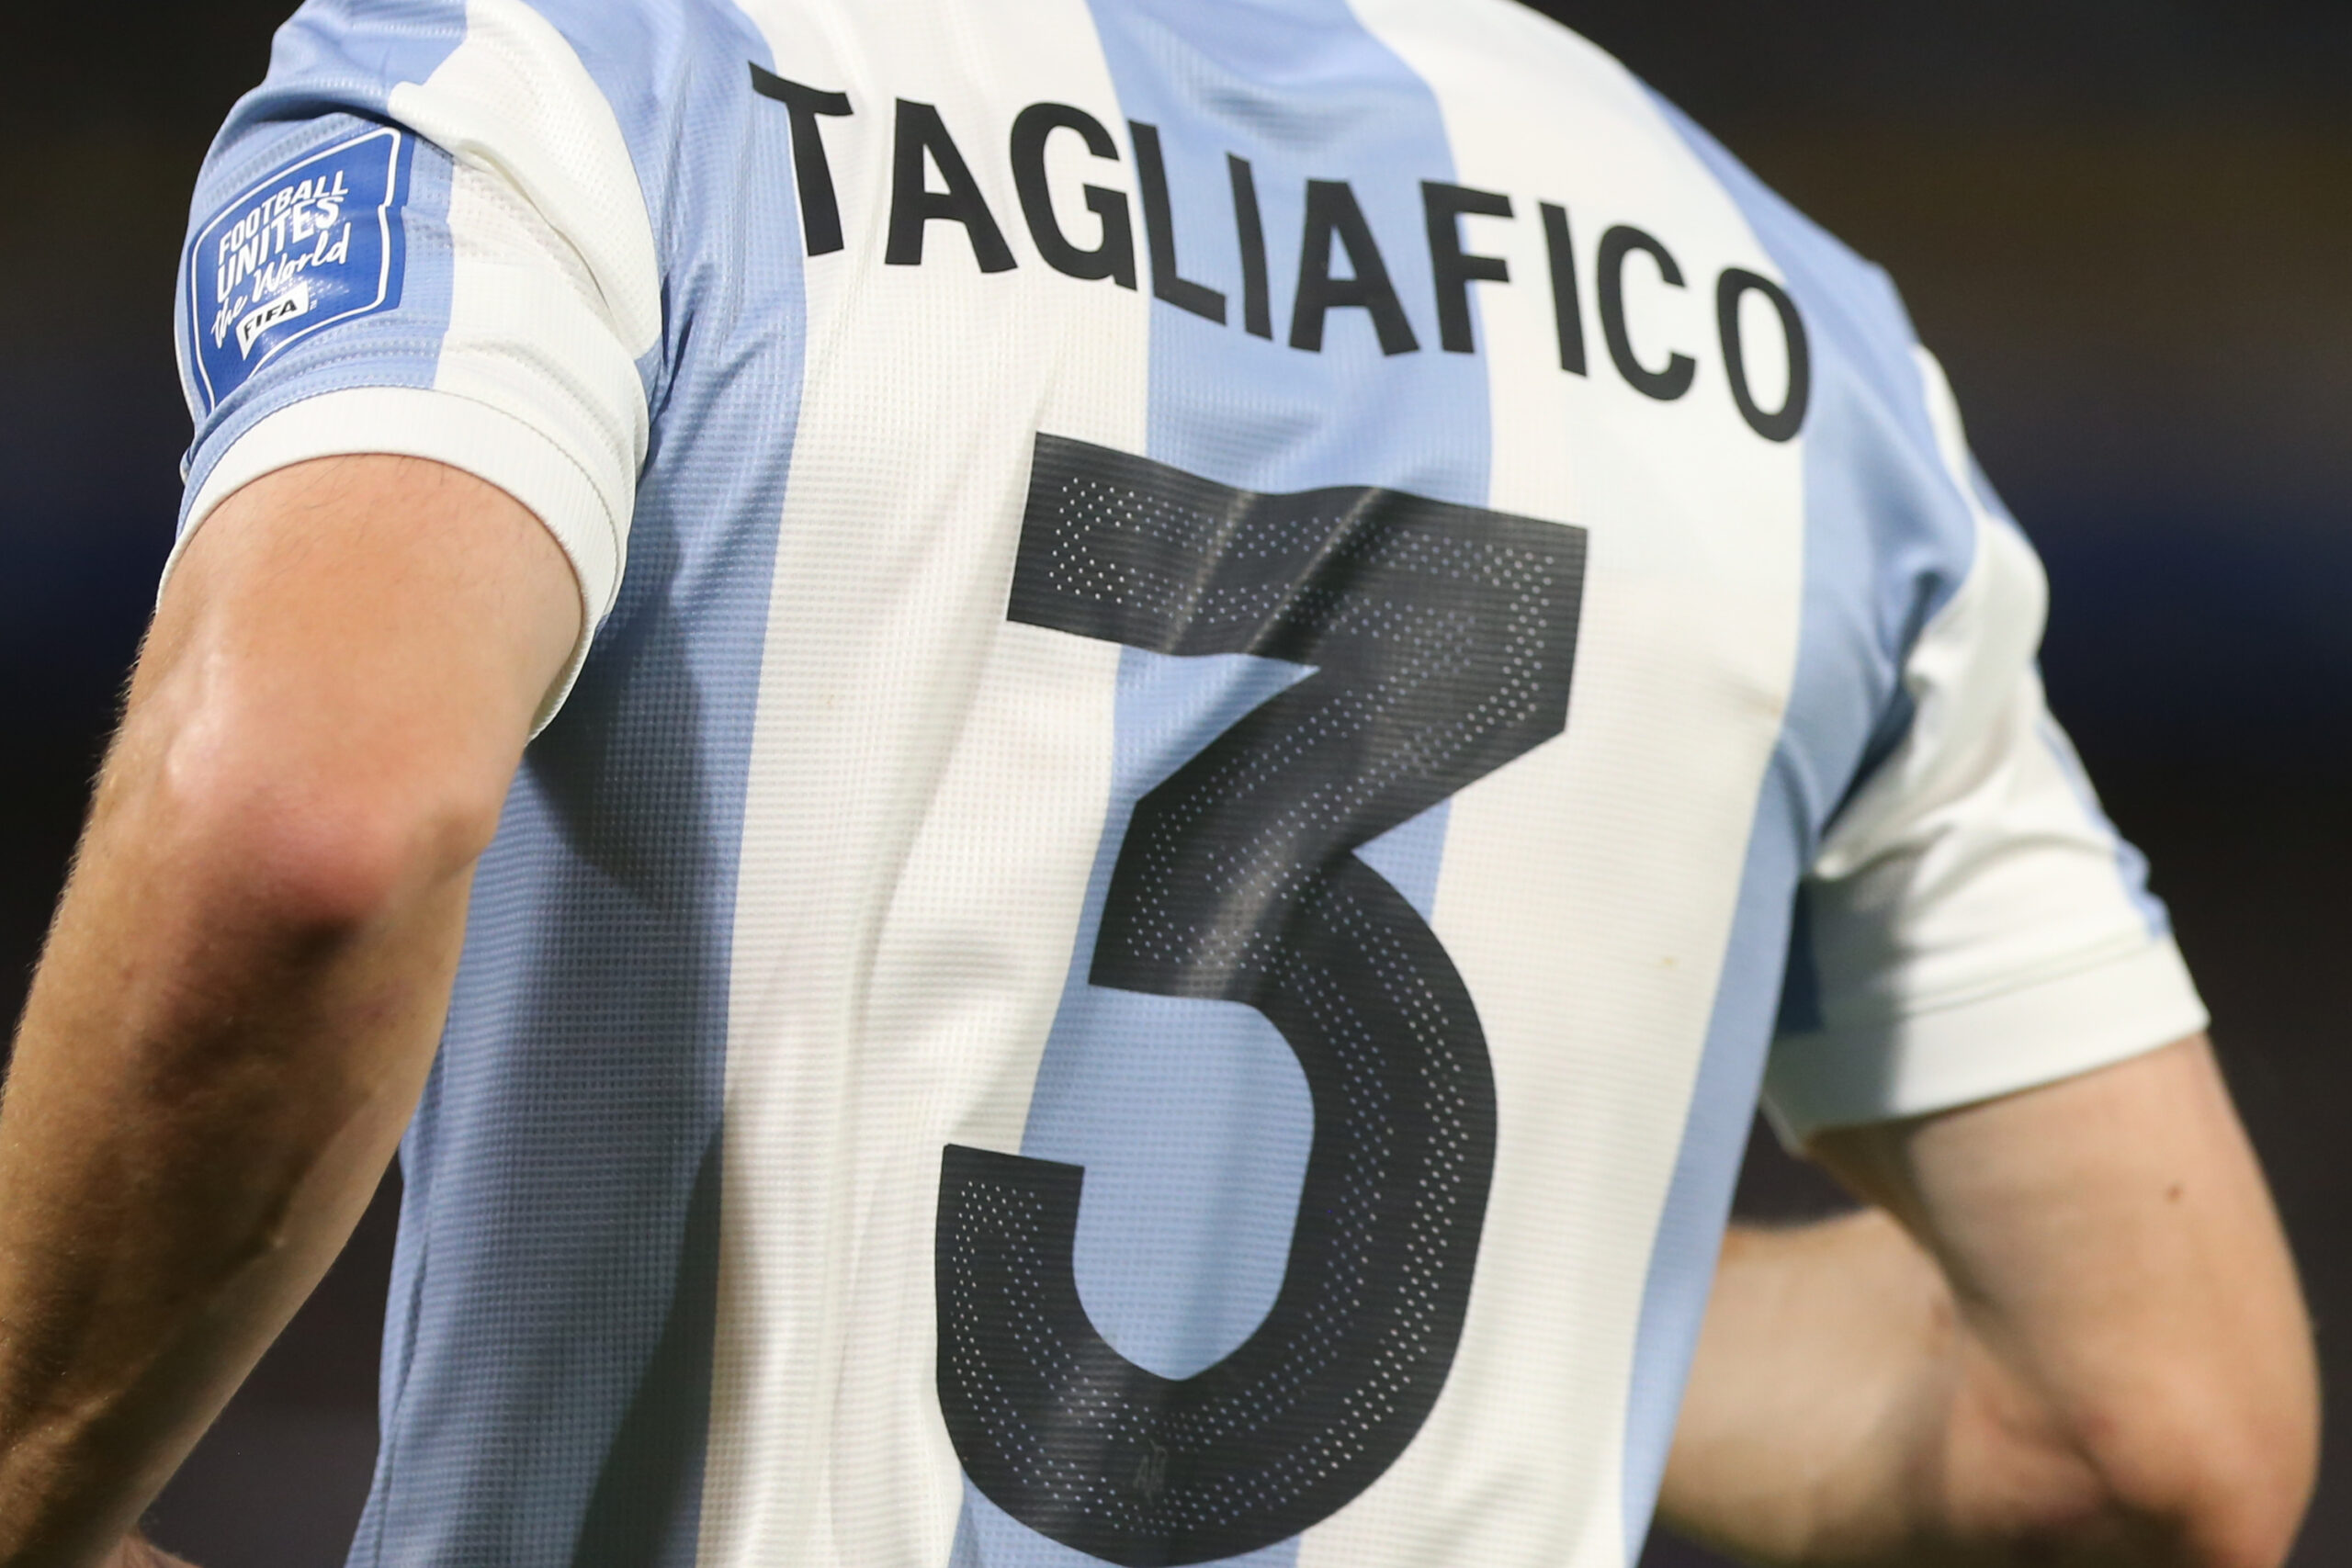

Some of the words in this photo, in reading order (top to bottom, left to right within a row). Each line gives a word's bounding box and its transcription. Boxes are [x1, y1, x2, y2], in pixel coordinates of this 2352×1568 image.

[217, 196, 345, 304] UNITES
[218, 170, 348, 265] FOOTBALL
[748, 59, 1812, 444] TAGLIAFICO
[210, 294, 248, 350] the
[252, 221, 352, 304] World
[243, 299, 298, 341] FIFA
[934, 430, 1589, 1568] 3
